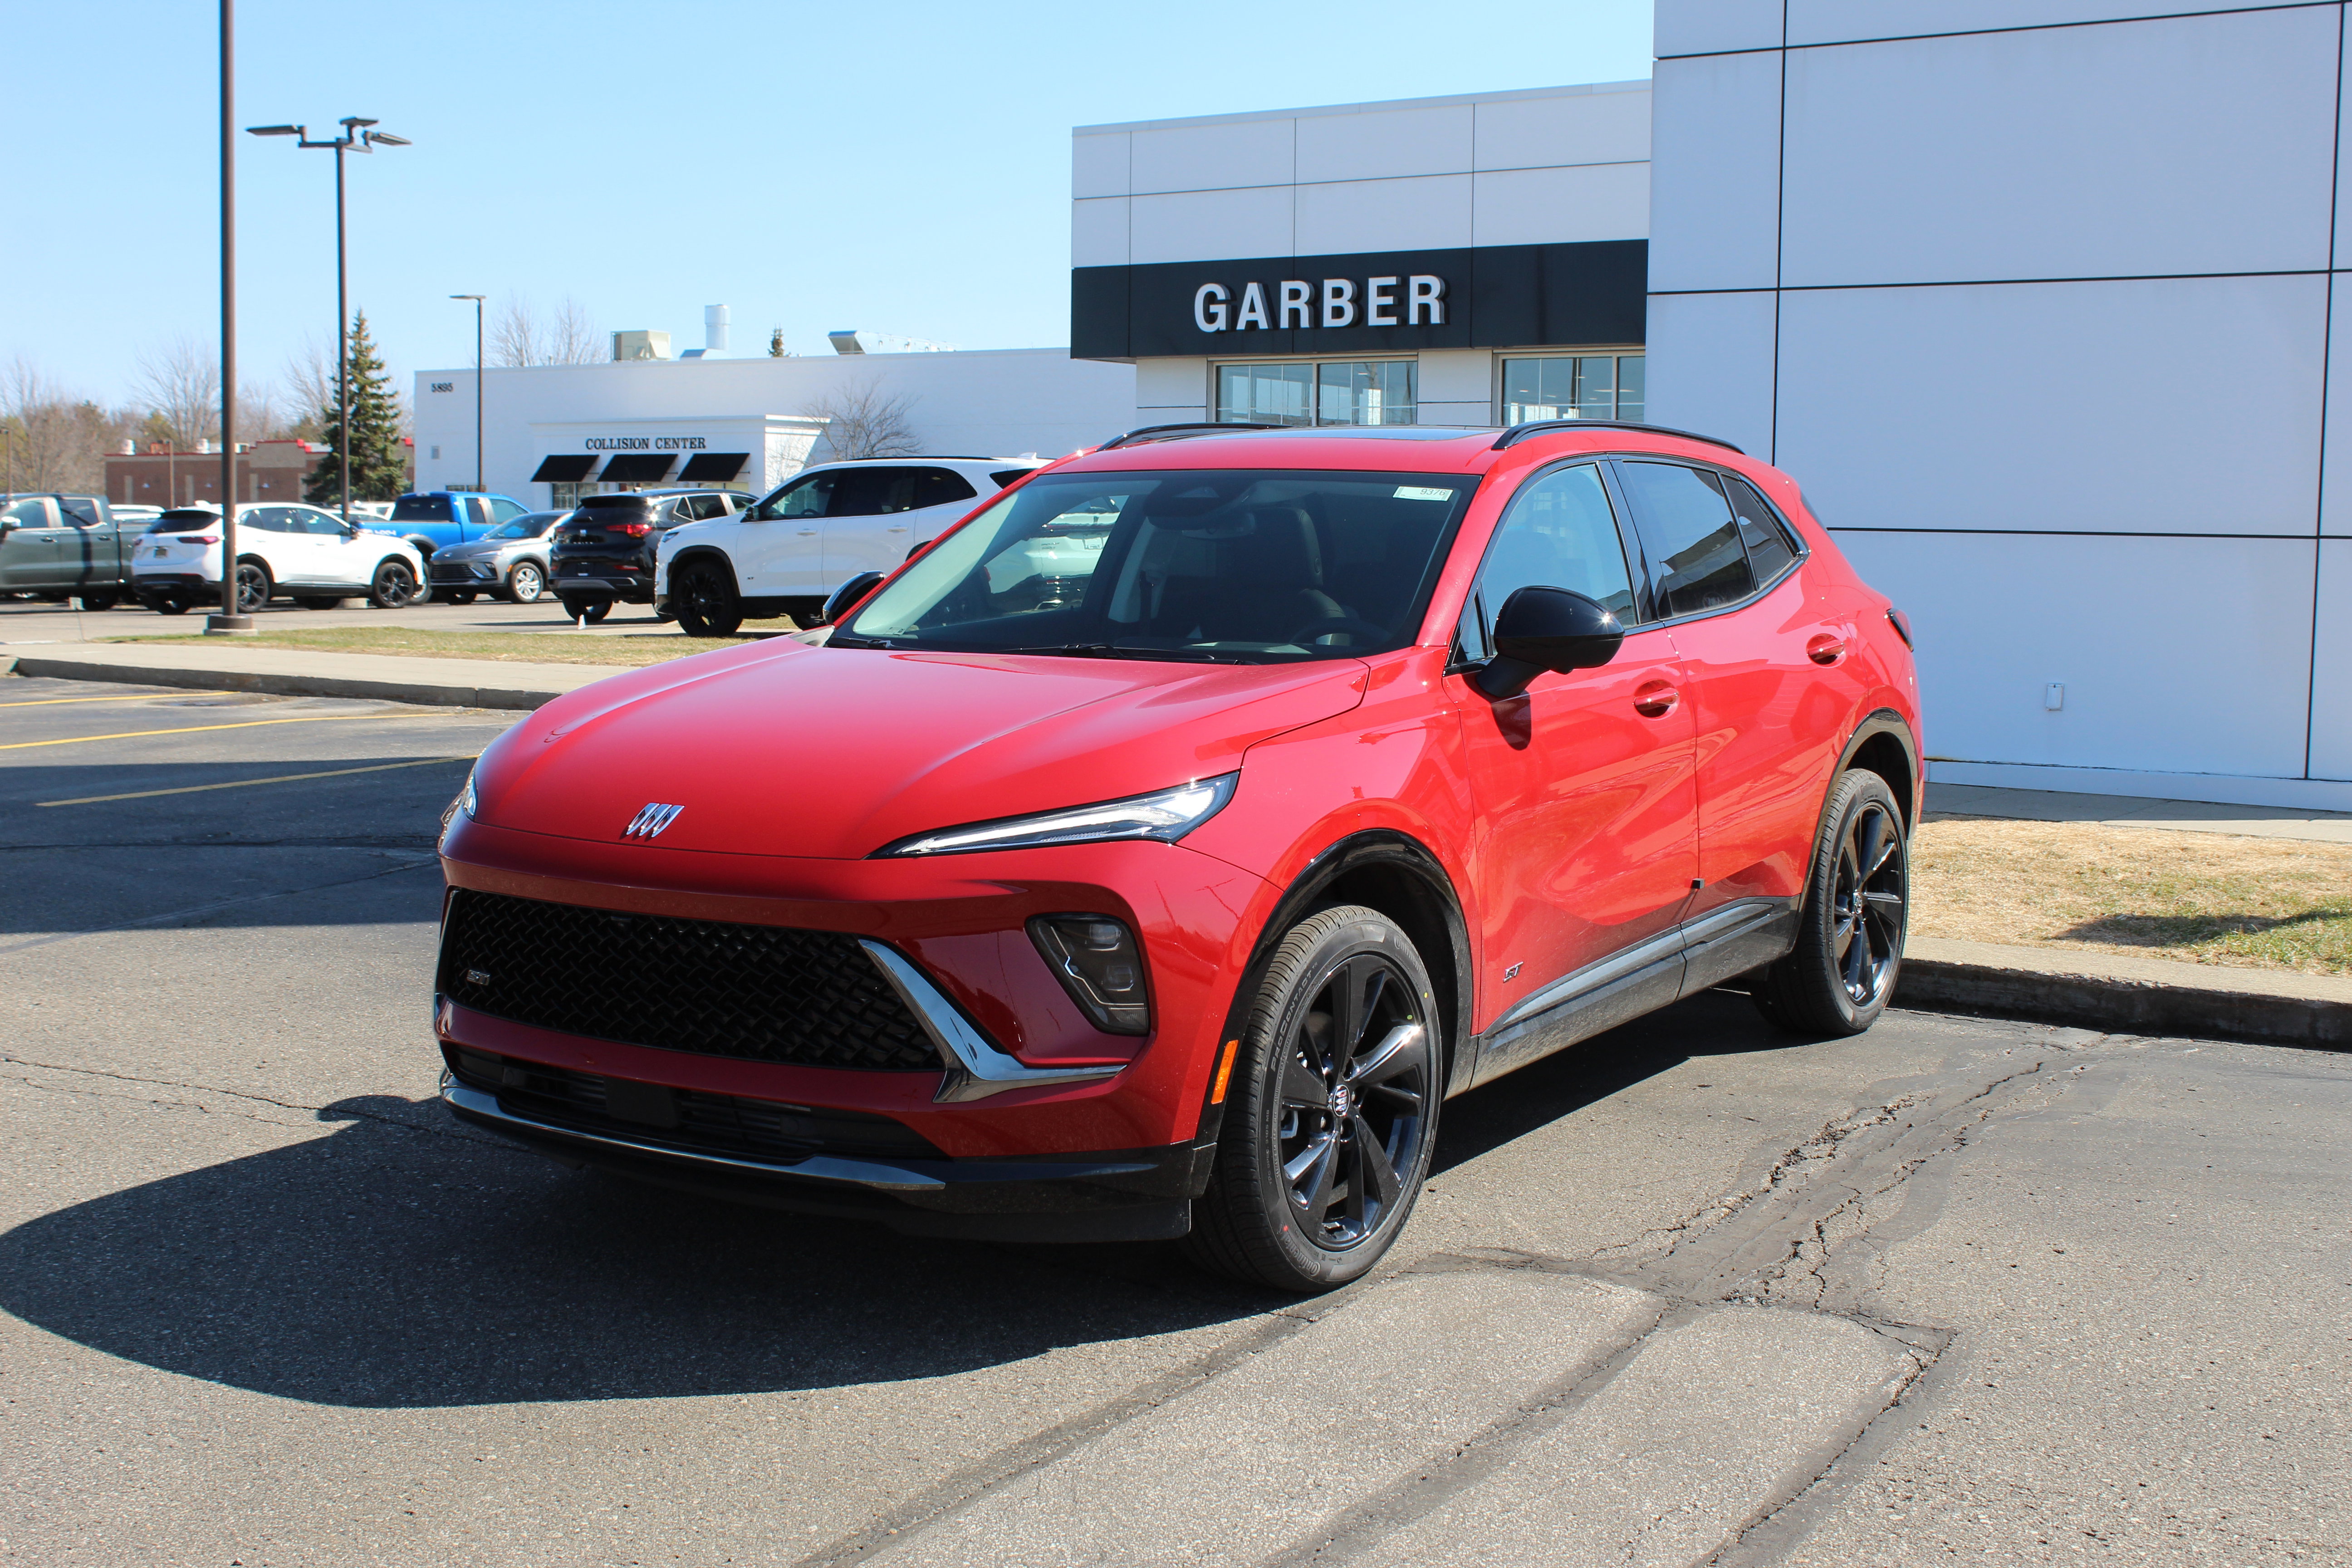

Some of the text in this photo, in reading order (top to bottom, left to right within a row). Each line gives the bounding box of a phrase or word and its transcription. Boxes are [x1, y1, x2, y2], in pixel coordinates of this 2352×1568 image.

[1194, 274, 1446, 333] GARBER
[586, 437, 706, 450] COLLISION CENTER
